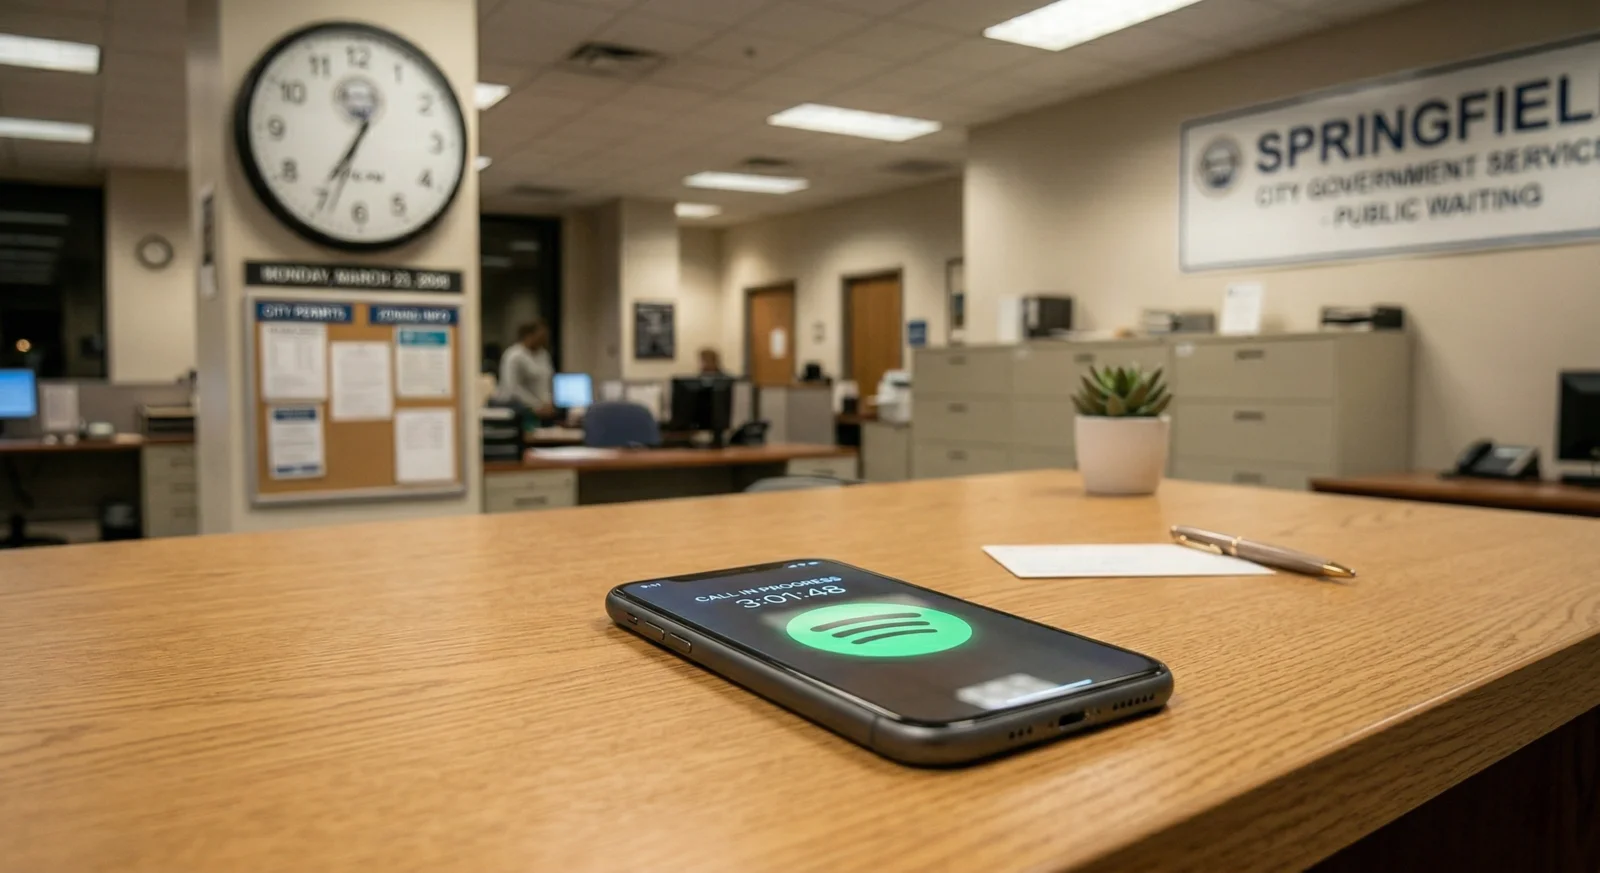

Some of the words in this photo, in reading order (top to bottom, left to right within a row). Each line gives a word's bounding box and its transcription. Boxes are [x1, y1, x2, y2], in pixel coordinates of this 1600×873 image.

[309, 55, 331, 77] 11
[347, 45, 371, 69] 12
[393, 62, 404, 83] 1
[281, 81, 306, 105] 10
[418, 91, 433, 116] 2
[267, 116, 285, 140] 9
[1255, 73, 1598, 174] SPRINGFIEL
[430, 131, 445, 154] 3
[281, 159, 298, 183] 8
[417, 168, 433, 188] 4
[1255, 183, 1300, 210] CITY
[1306, 154, 1478, 201] GOVERNMENT
[314, 187, 329, 213] 7
[390, 192, 406, 216] 5
[1333, 200, 1420, 230] PUBLIC
[1427, 182, 1545, 218] WAITING
[352, 201, 369, 225] 6
[262, 303, 292, 318] CITY
[694, 592, 740, 602] CALL
[738, 588, 759, 596] IN
[758, 576, 842, 593] PROGRESS
[735, 585, 847, 608] 3:01:48
